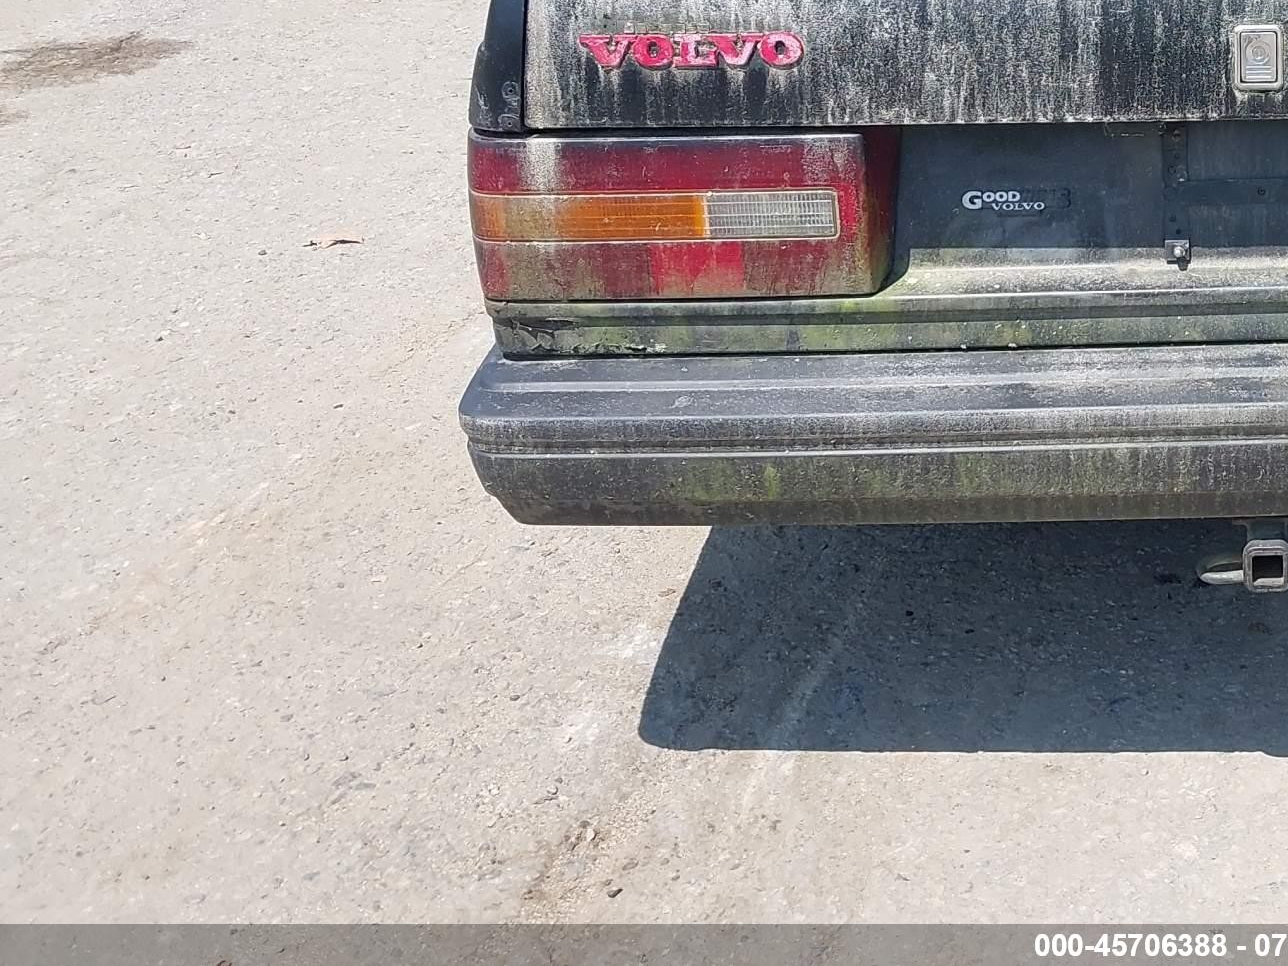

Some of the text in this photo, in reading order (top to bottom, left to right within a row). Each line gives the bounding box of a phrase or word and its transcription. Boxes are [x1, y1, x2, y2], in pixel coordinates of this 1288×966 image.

[578, 33, 804, 68] VOLVO
[961, 190, 1021, 210] GOOD
[991, 201, 1045, 211] VOLVO
